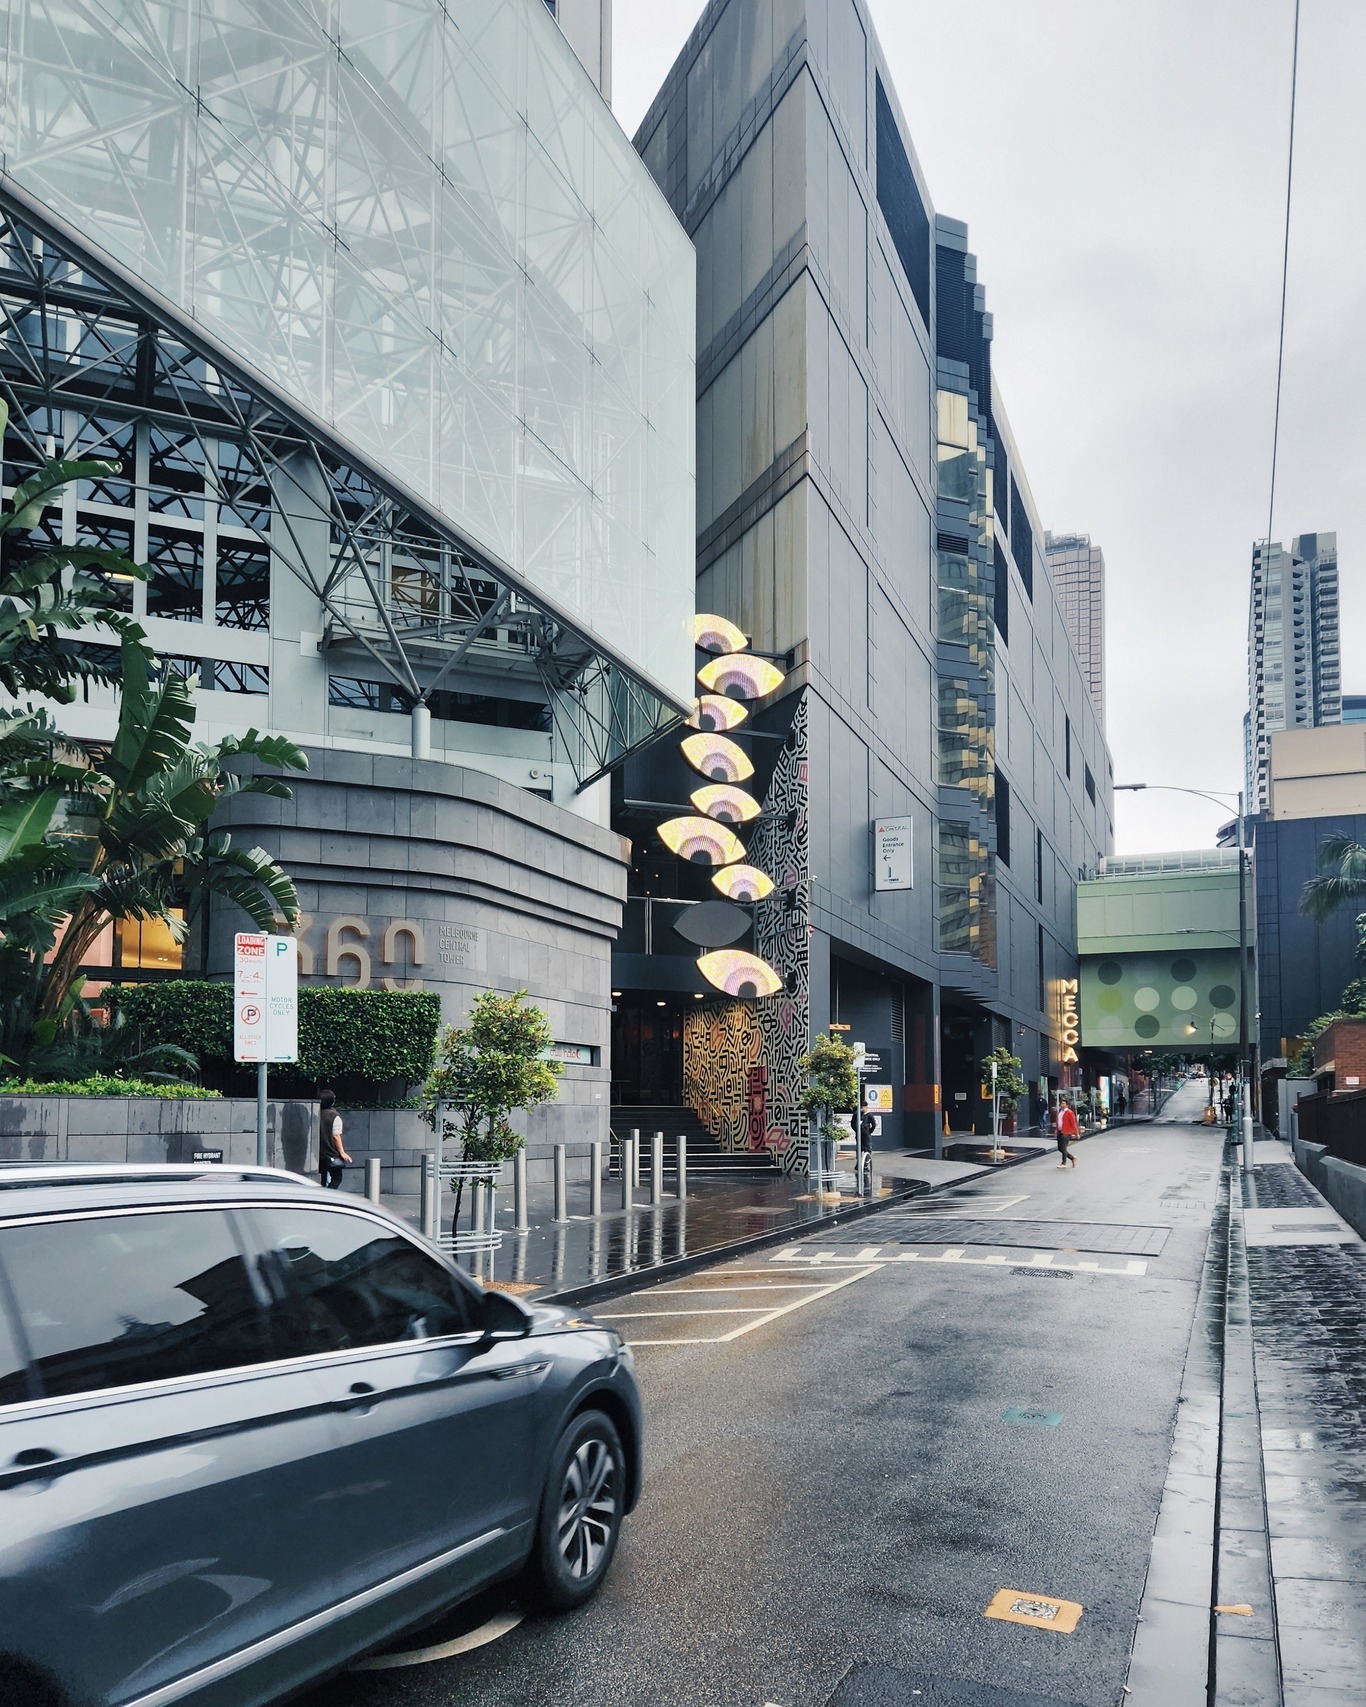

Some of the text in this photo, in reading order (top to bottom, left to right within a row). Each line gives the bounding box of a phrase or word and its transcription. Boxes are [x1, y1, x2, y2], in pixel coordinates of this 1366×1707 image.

[438, 925, 479, 942] MELBOURNE
[238, 936, 265, 946] LOADING
[439, 938, 471, 953] CENTRAL
[237, 945, 265, 956] ZONE
[276, 942, 288, 956] P
[438, 952, 465, 965] TOWER
[1060, 978, 1078, 1062] MECCA
